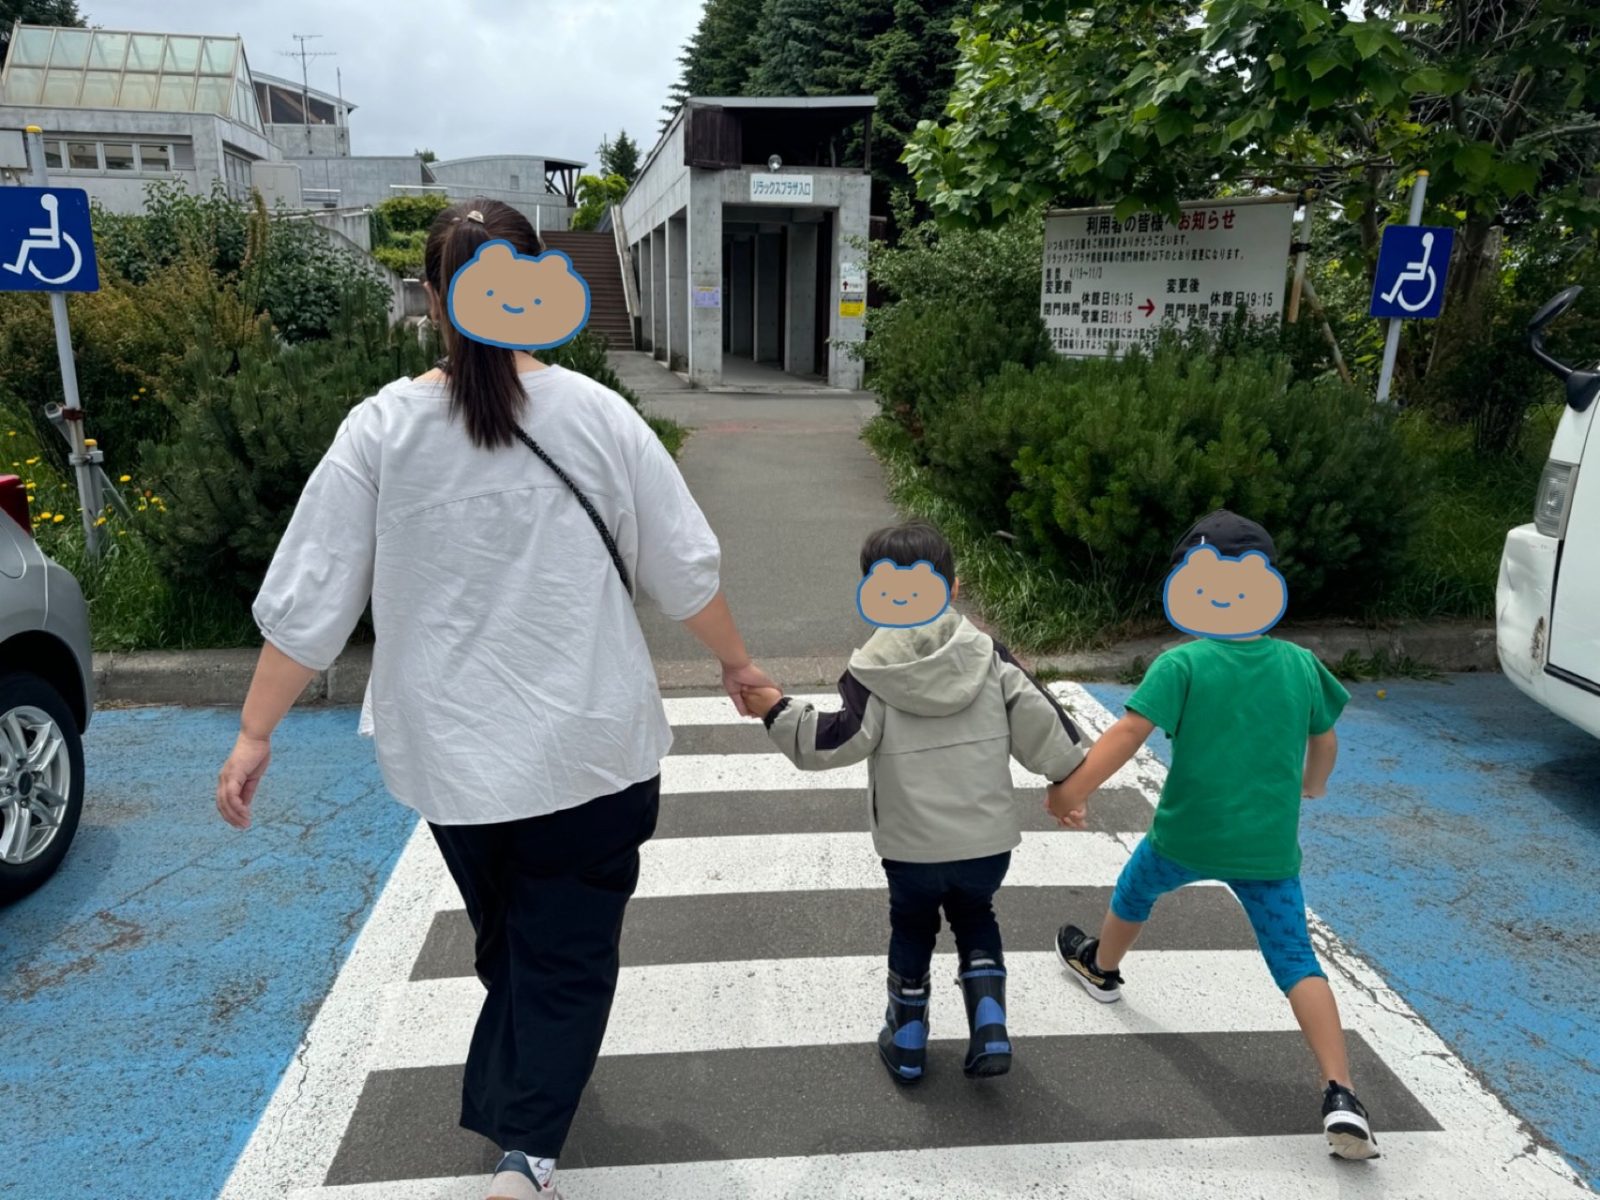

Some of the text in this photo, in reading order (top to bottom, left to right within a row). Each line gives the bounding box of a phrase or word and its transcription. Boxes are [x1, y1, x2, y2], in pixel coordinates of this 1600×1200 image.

[752, 179, 811, 196] リラックスプラザ入口
[1045, 280, 1072, 294] 変更前
[1166, 278, 1200, 293] 変更後
[1082, 291, 1134, 306] 休館日19:15
[1043, 302, 1081, 316] 閉門時間
[1081, 310, 1133, 324] 営業日21:15
